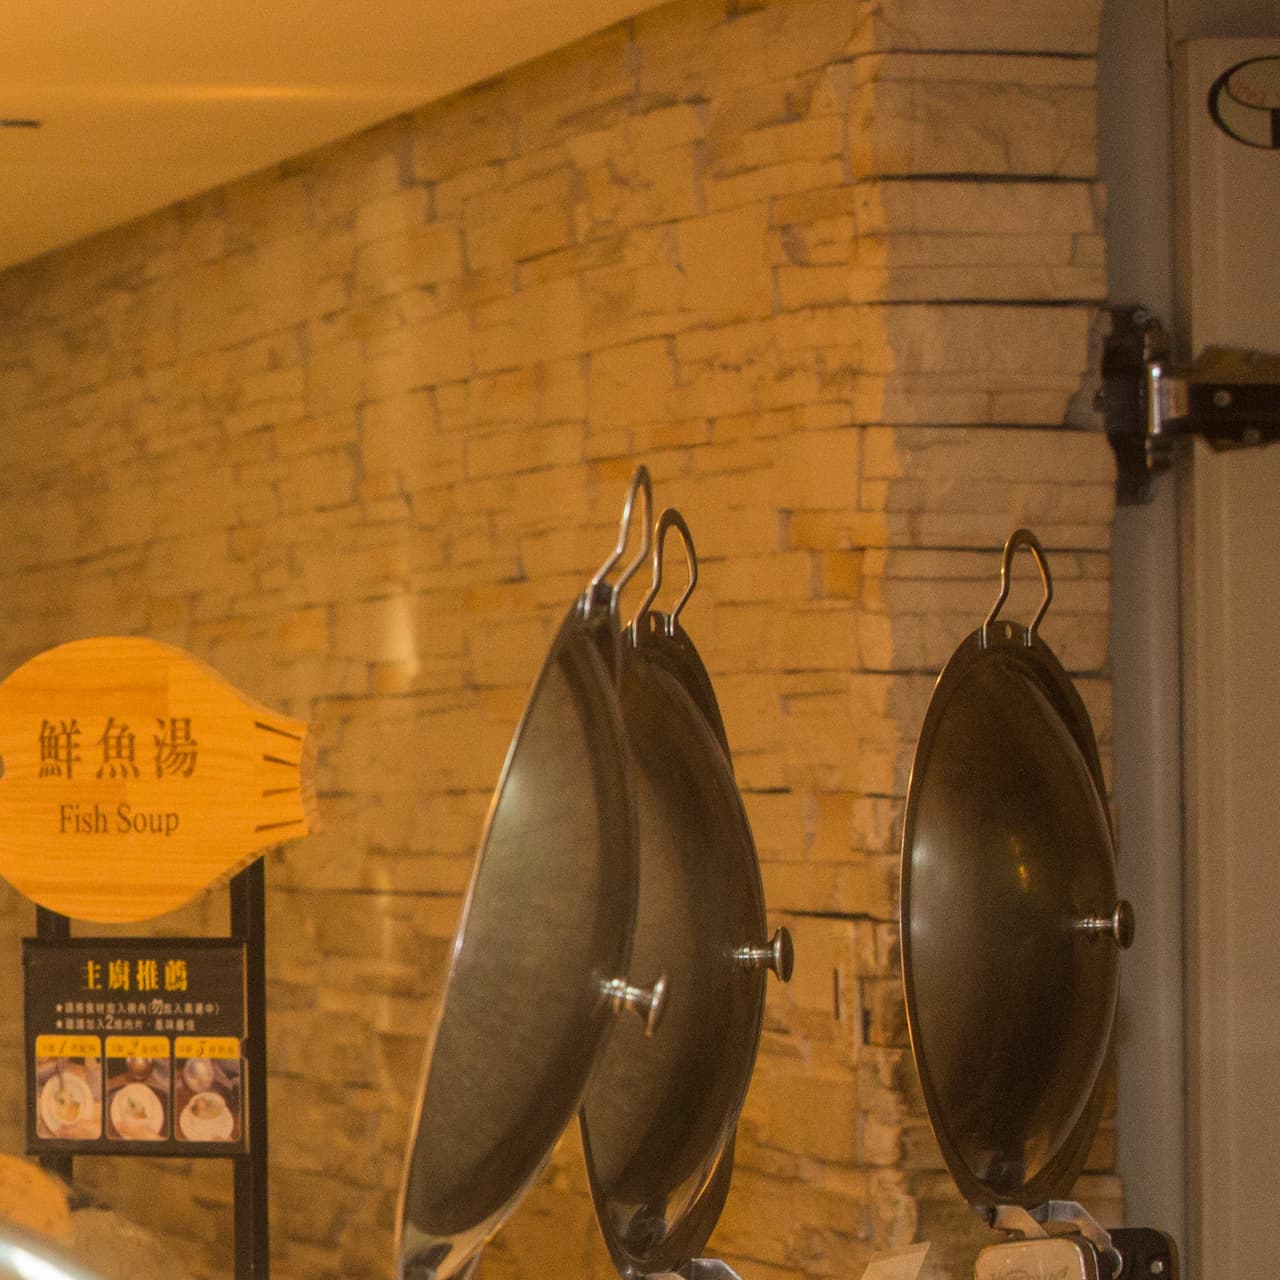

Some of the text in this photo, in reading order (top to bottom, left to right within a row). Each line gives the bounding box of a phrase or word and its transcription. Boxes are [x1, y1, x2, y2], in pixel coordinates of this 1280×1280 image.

[38, 716, 199, 780] 鮮魚湯
[59, 803, 180, 838] Fish Soup
